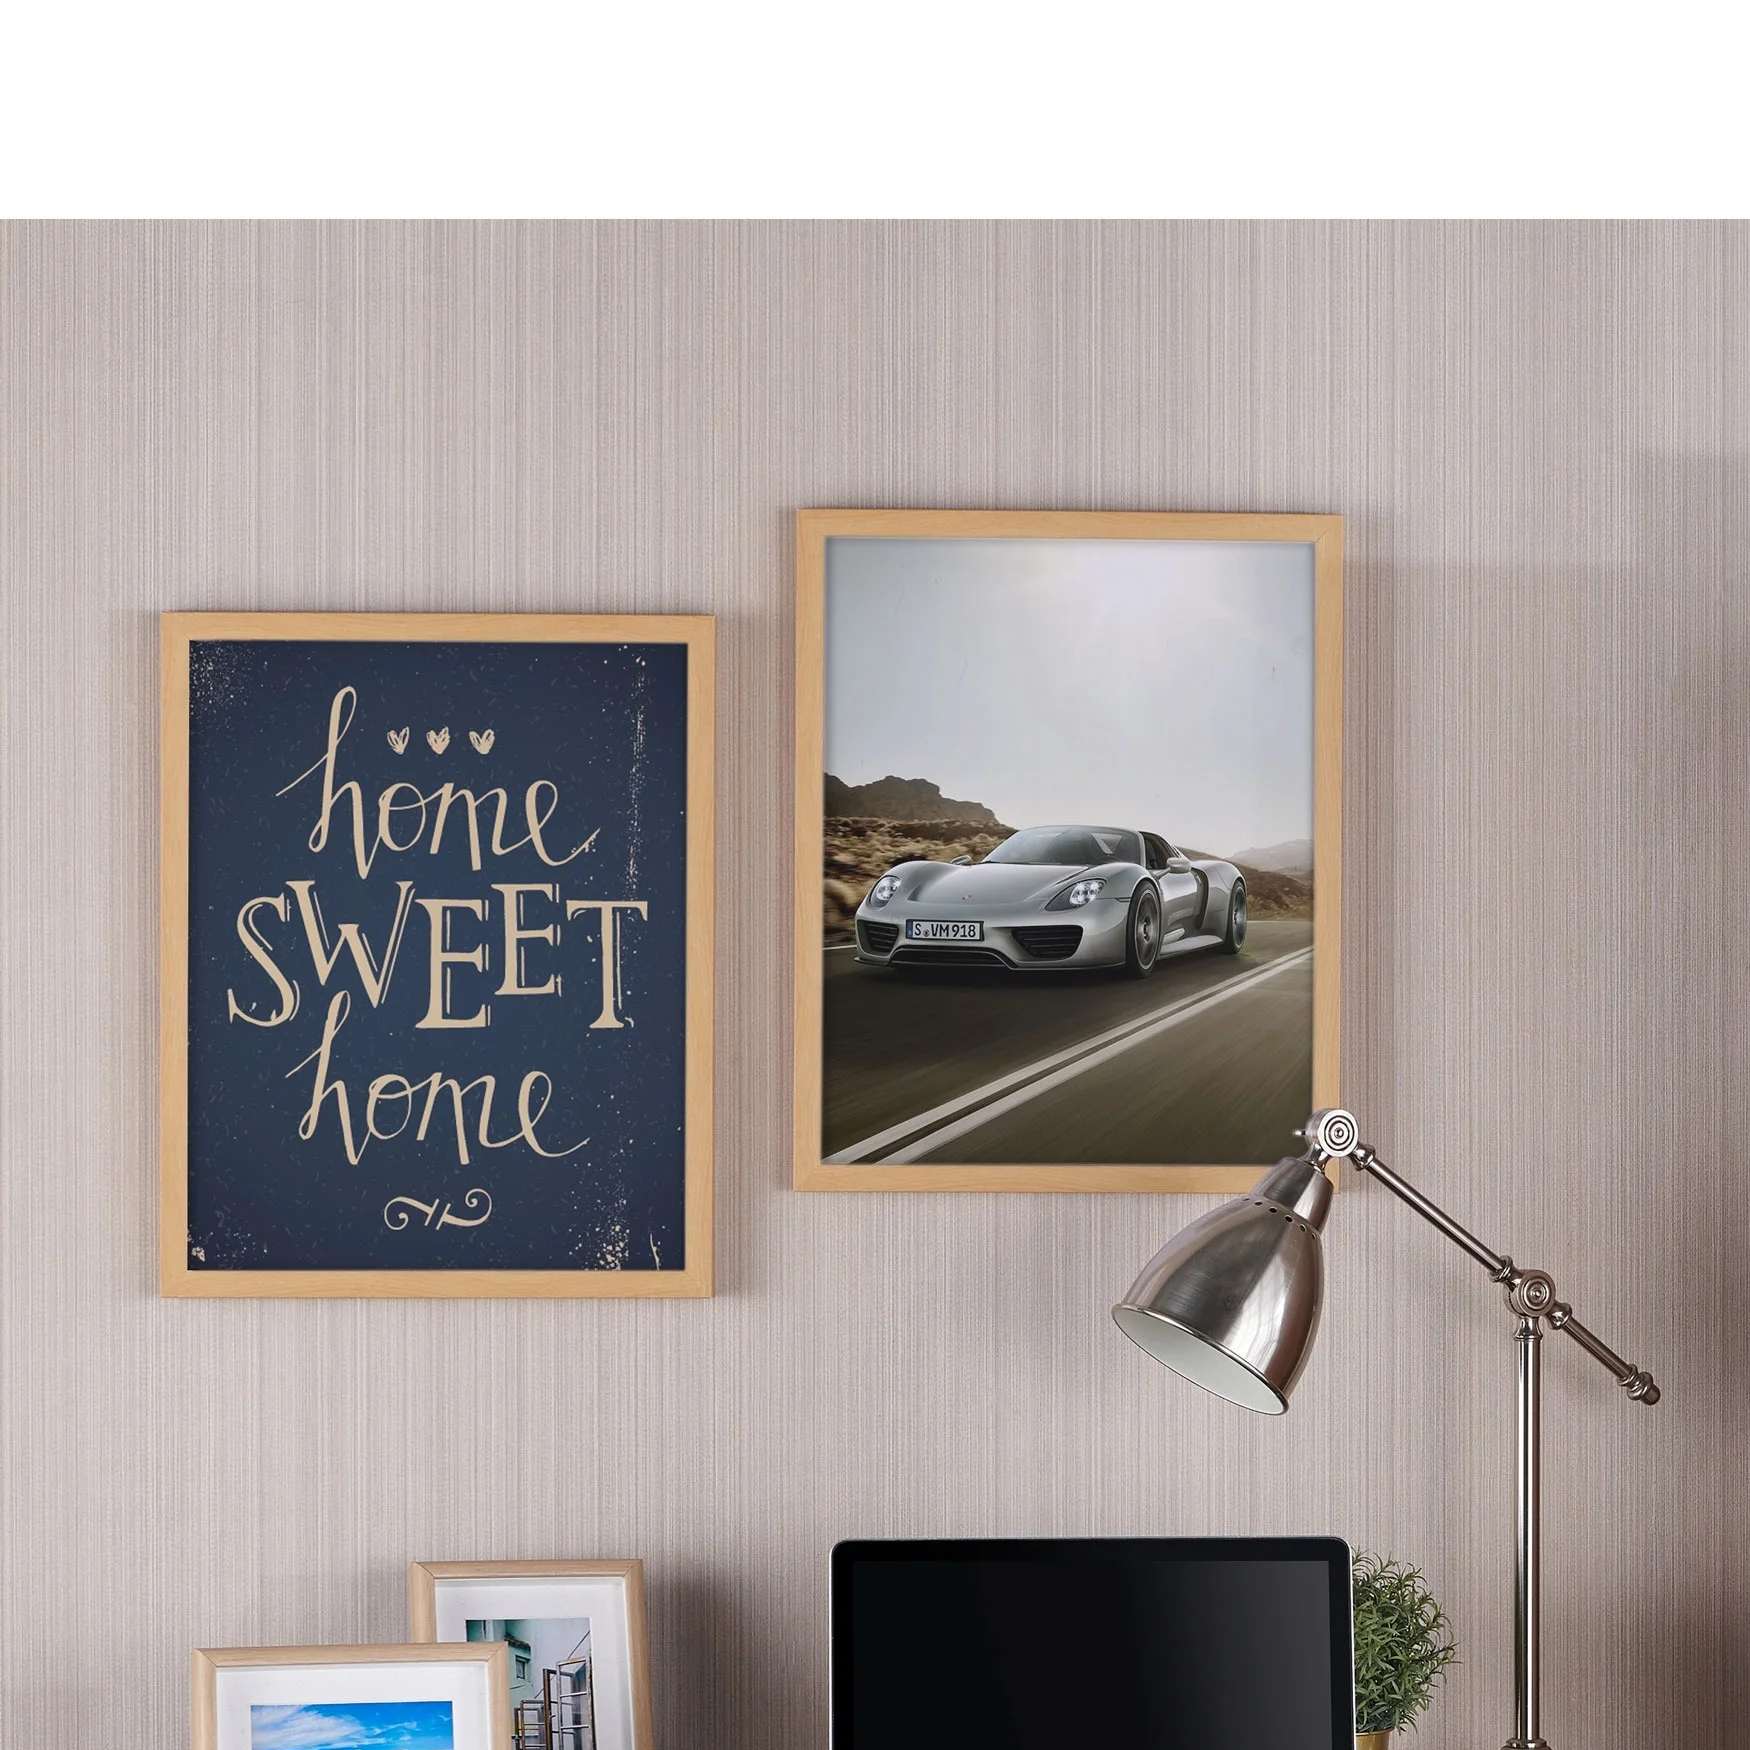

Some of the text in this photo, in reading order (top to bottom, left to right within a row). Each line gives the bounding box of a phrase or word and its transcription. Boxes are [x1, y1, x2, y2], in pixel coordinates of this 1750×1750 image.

[276, 686, 601, 879] home
[228, 880, 648, 1029] SWEET
[914, 923, 922, 936] S
[286, 990, 591, 1166] home
